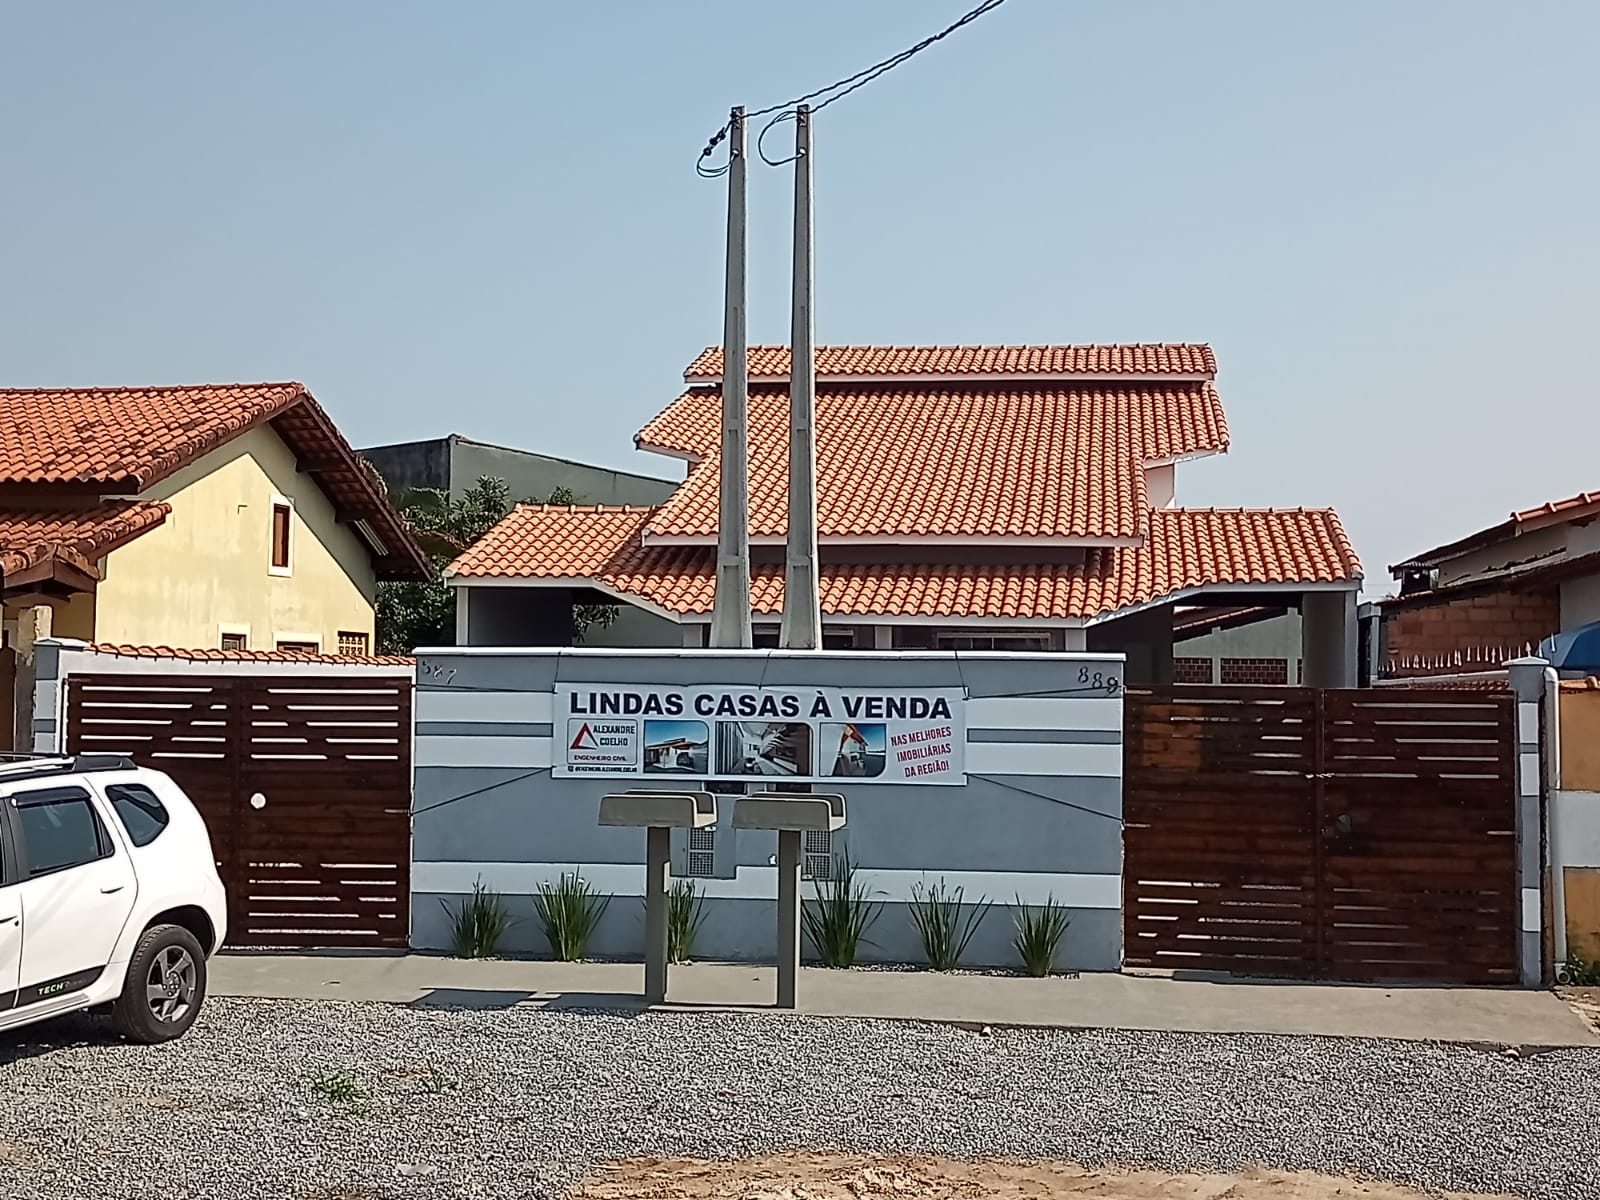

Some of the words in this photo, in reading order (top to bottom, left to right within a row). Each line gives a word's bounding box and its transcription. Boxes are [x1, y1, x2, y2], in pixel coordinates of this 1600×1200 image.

[1078, 665, 1119, 697] 889
[570, 691, 684, 716] LINDAS
[694, 693, 800, 717] CASAS
[809, 690, 832, 718] À
[842, 696, 952, 719] VENDA
[593, 725, 636, 734] ALEXANDRE
[890, 734, 908, 747] NAS
[908, 726, 952, 744] MELHORES
[600, 737, 629, 746] COELHO
[574, 754, 612, 762] ENGENHEIRO
[896, 743, 952, 762] IMOBILIÁRIAS
[904, 766, 917, 778] DA
[917, 760, 950, 776] REGIÃO!
